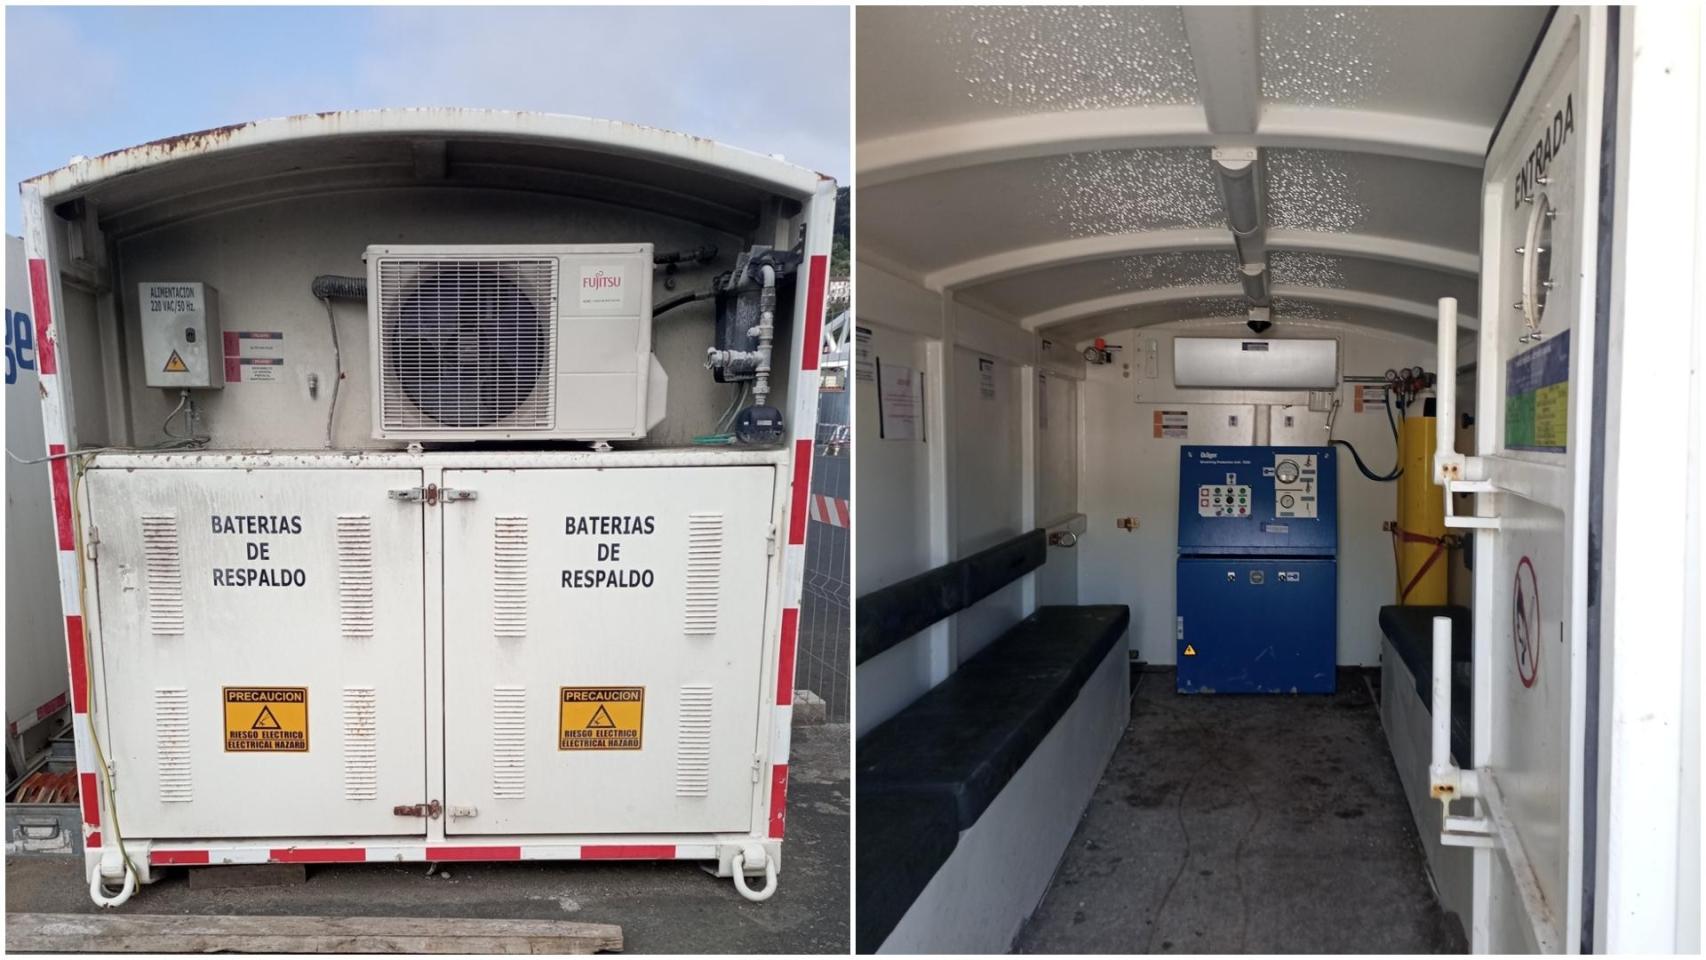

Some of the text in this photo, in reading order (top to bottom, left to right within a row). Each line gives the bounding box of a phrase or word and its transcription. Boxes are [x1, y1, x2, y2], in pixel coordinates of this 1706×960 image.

[1514, 93, 1574, 210] ENTRADA
[583, 270, 621, 290] FUJITSU
[150, 287, 195, 298] ALIMENTACION
[150, 300, 161, 312] 220
[211, 515, 302, 534] BATERIAS
[565, 515, 655, 535] BATERIAS
[246, 542, 270, 560] DE
[597, 543, 620, 561] DE
[212, 568, 306, 587] RESPALDO
[561, 569, 654, 588] RESPALDO
[228, 691, 302, 701] PRECAUCION
[566, 691, 639, 701] PRECAUCION
[229, 730, 304, 739] RIESGO ELECTRICO
[564, 729, 637, 738] RIESGO ELECTRICO
[228, 741, 306, 749] ELECTRICAL HAZARD
[561, 739, 640, 747] ELECTRICAL HAZARD
